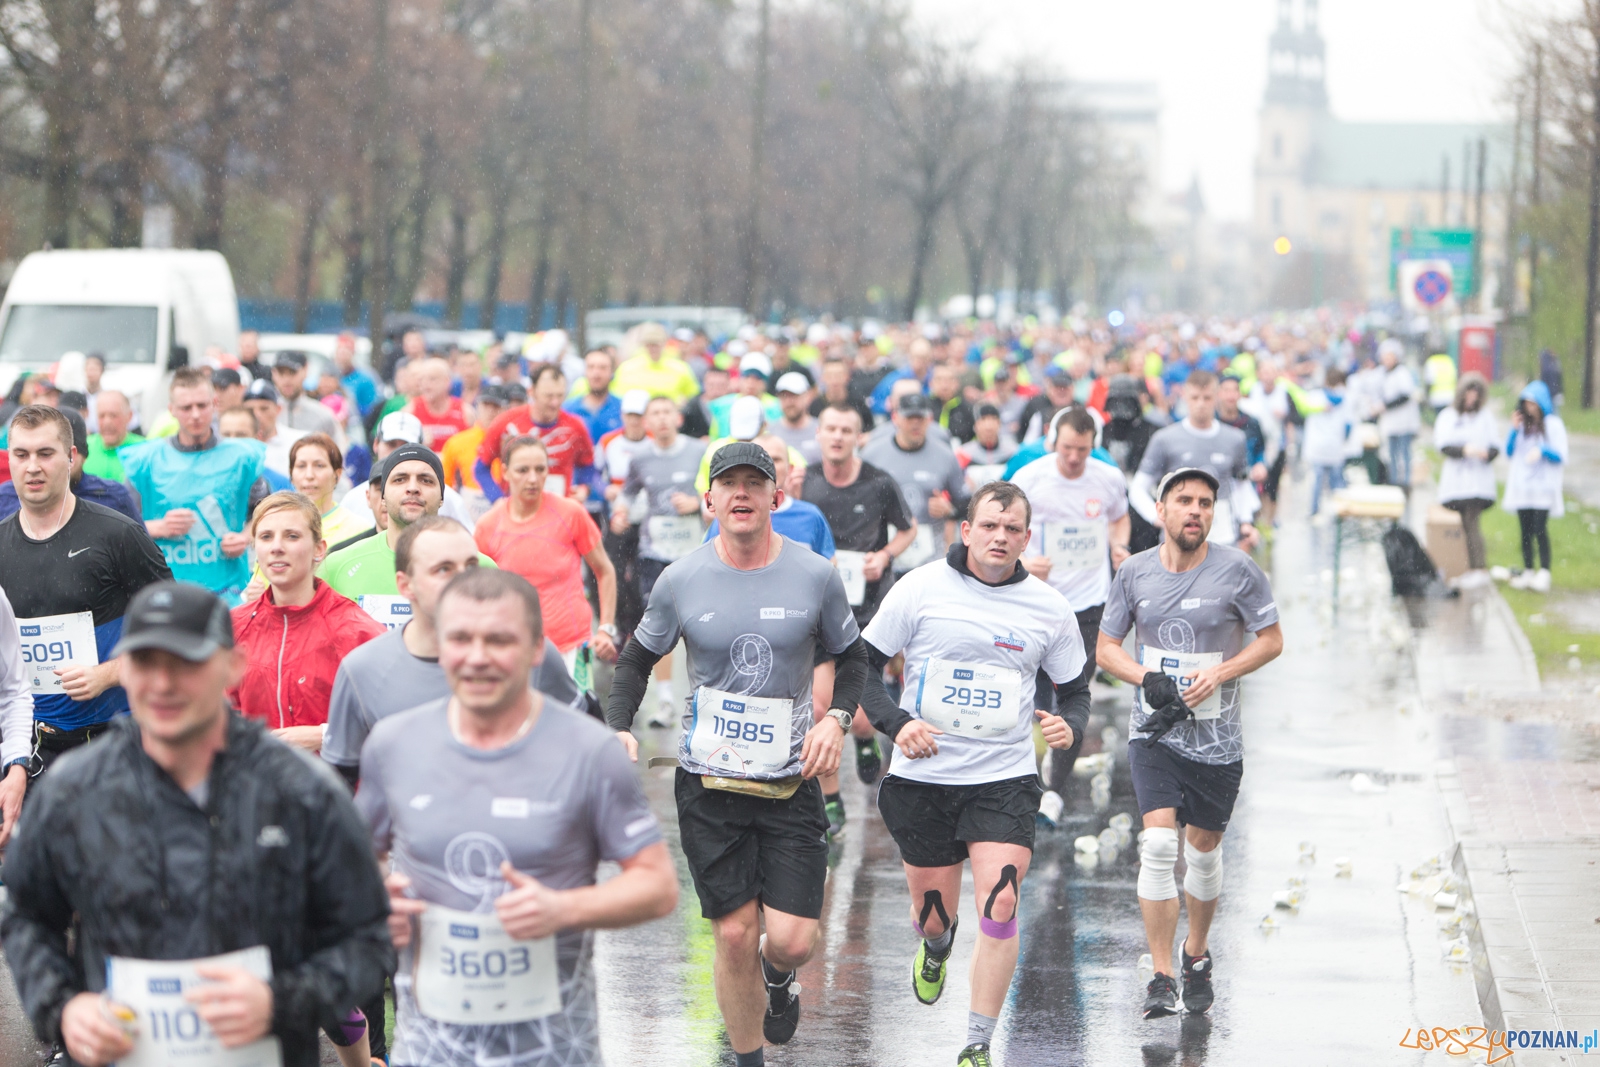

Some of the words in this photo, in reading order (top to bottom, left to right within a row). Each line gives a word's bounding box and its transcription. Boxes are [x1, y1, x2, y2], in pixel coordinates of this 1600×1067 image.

[160, 538, 225, 564] adid
[941, 685, 1003, 709] 2933
[713, 715, 775, 744] 11985
[731, 742, 750, 751] Kamil
[440, 945, 531, 979] 3603
[150, 1008, 215, 1042] 110
